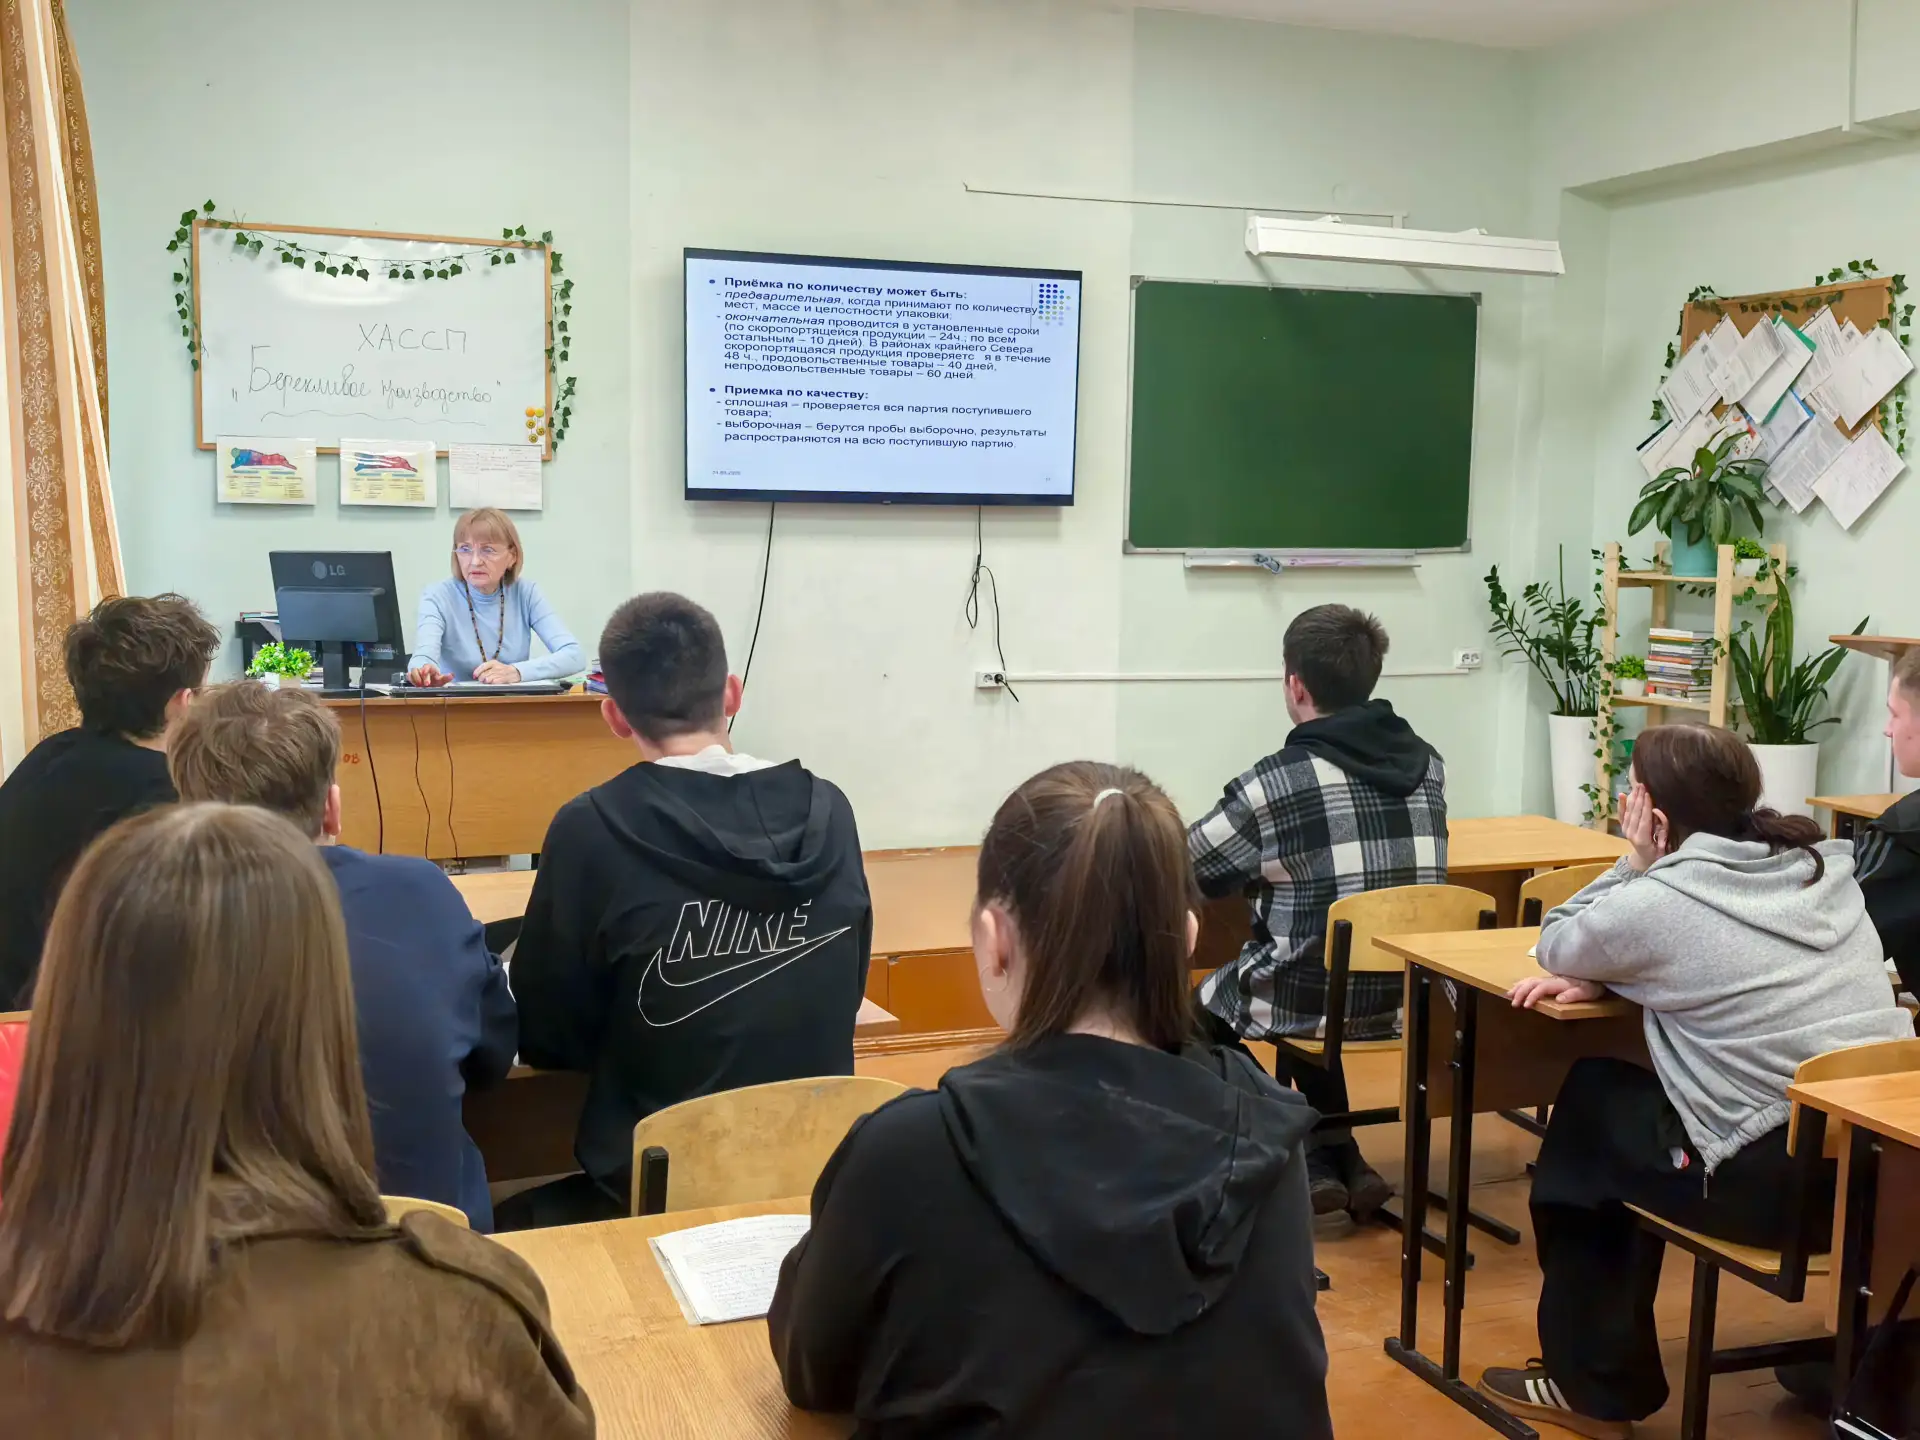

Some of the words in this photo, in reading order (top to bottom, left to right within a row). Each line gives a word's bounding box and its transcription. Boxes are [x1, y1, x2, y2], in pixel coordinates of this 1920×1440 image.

[724, 278, 783, 288] Приёмка
[788, 282, 803, 291] по
[808, 283, 882, 295] количеству
[887, 288, 927, 297] может
[931, 289, 967, 299] быть:
[725, 301, 758, 311] мест,
[763, 303, 800, 311] массе
[816, 306, 892, 316] целостности
[885, 300, 952, 310] принимают
[956, 303, 969, 311] по
[973, 304, 1037, 315] количеству
[724, 322, 744, 332] (по
[748, 325, 858, 337] скоропортящейся
[863, 330, 925, 341] продукции
[725, 313, 824, 325] окончательная
[829, 319, 898, 330] проводится
[913, 323, 1003, 333] установленные
[358, 323, 467, 354] ХАССП
[724, 333, 794, 343] остальным
[812, 336, 824, 344] 10
[870, 338, 877, 347] В
[882, 340, 930, 350] районах
[935, 342, 987, 352] крайнего
[990, 344, 1032, 354] Севера
[724, 343, 836, 355] скоропортящаяся
[840, 348, 902, 358] продукция
[724, 351, 739, 360] 48
[762, 354, 886, 366] продовольственные
[892, 360, 933, 369] товары
[724, 363, 865, 375] непродовольственные
[870, 368, 912, 378] товары
[927, 370, 941, 378] 60
[725, 385, 783, 396] Приемка
[807, 390, 868, 400] качеству:
[725, 399, 788, 408] сплошная
[803, 401, 880, 411] проверяется
[884, 404, 903, 412] вся
[908, 405, 948, 414] партия
[952, 407, 1032, 416] поступившего
[725, 409, 772, 418] товара;
[725, 420, 801, 430] выборочная
[816, 422, 864, 433] берутся
[869, 424, 906, 434] пробы
[981, 428, 1046, 437] результаты
[724, 433, 840, 444] распространяются
[862, 437, 886, 445] всю
[889, 438, 968, 448] поступившую
[329, 564, 347, 577] LG
[666, 898, 813, 964] NIKE
